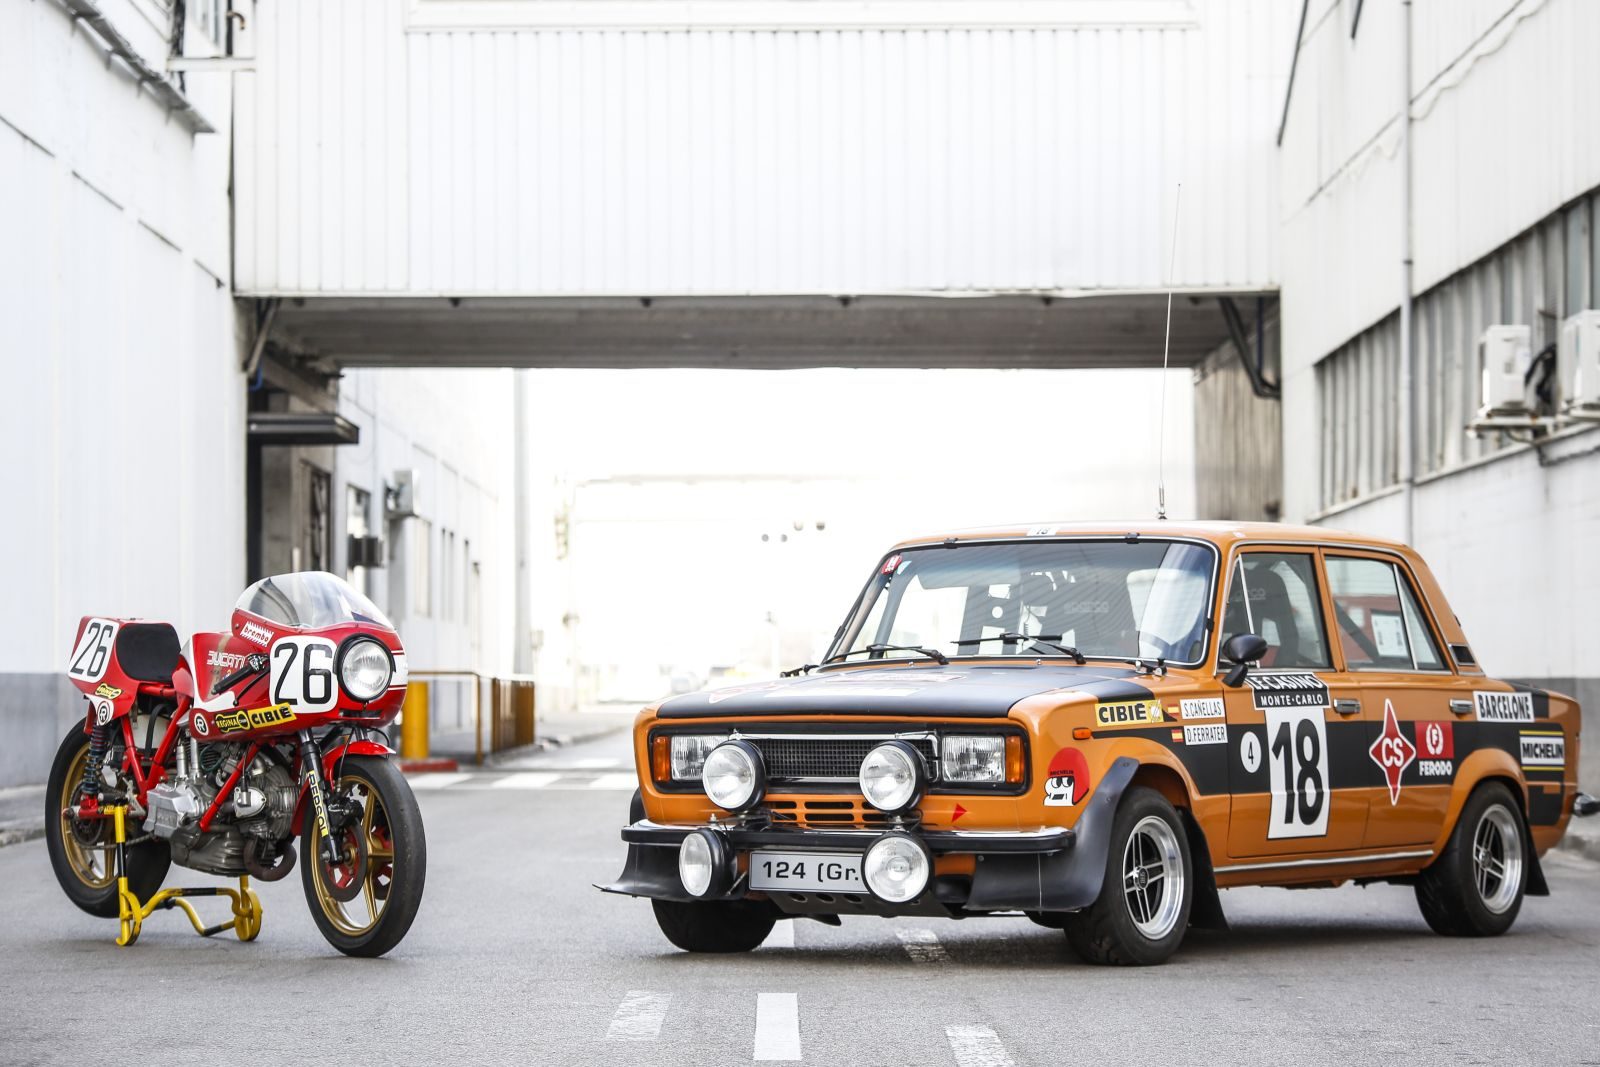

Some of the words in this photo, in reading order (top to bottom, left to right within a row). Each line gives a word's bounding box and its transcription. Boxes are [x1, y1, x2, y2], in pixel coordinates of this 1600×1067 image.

[243, 626, 270, 642] brembo
[69, 622, 114, 677] 26
[273, 642, 333, 706] 26
[1262, 675, 1324, 690] CASINO
[1477, 694, 1531, 720] BARCELONE
[216, 716, 239, 728] REGINA
[1186, 725, 1226, 743] D.FERRATER
[1248, 741, 1254, 765] 4
[1381, 737, 1405, 768] CS
[1521, 742, 1564, 759] MICHELIN
[1271, 718, 1325, 826] 18
[1418, 760, 1453, 777] FERODO
[762, 861, 806, 879] 124
[817, 862, 859, 883] (Gr.
